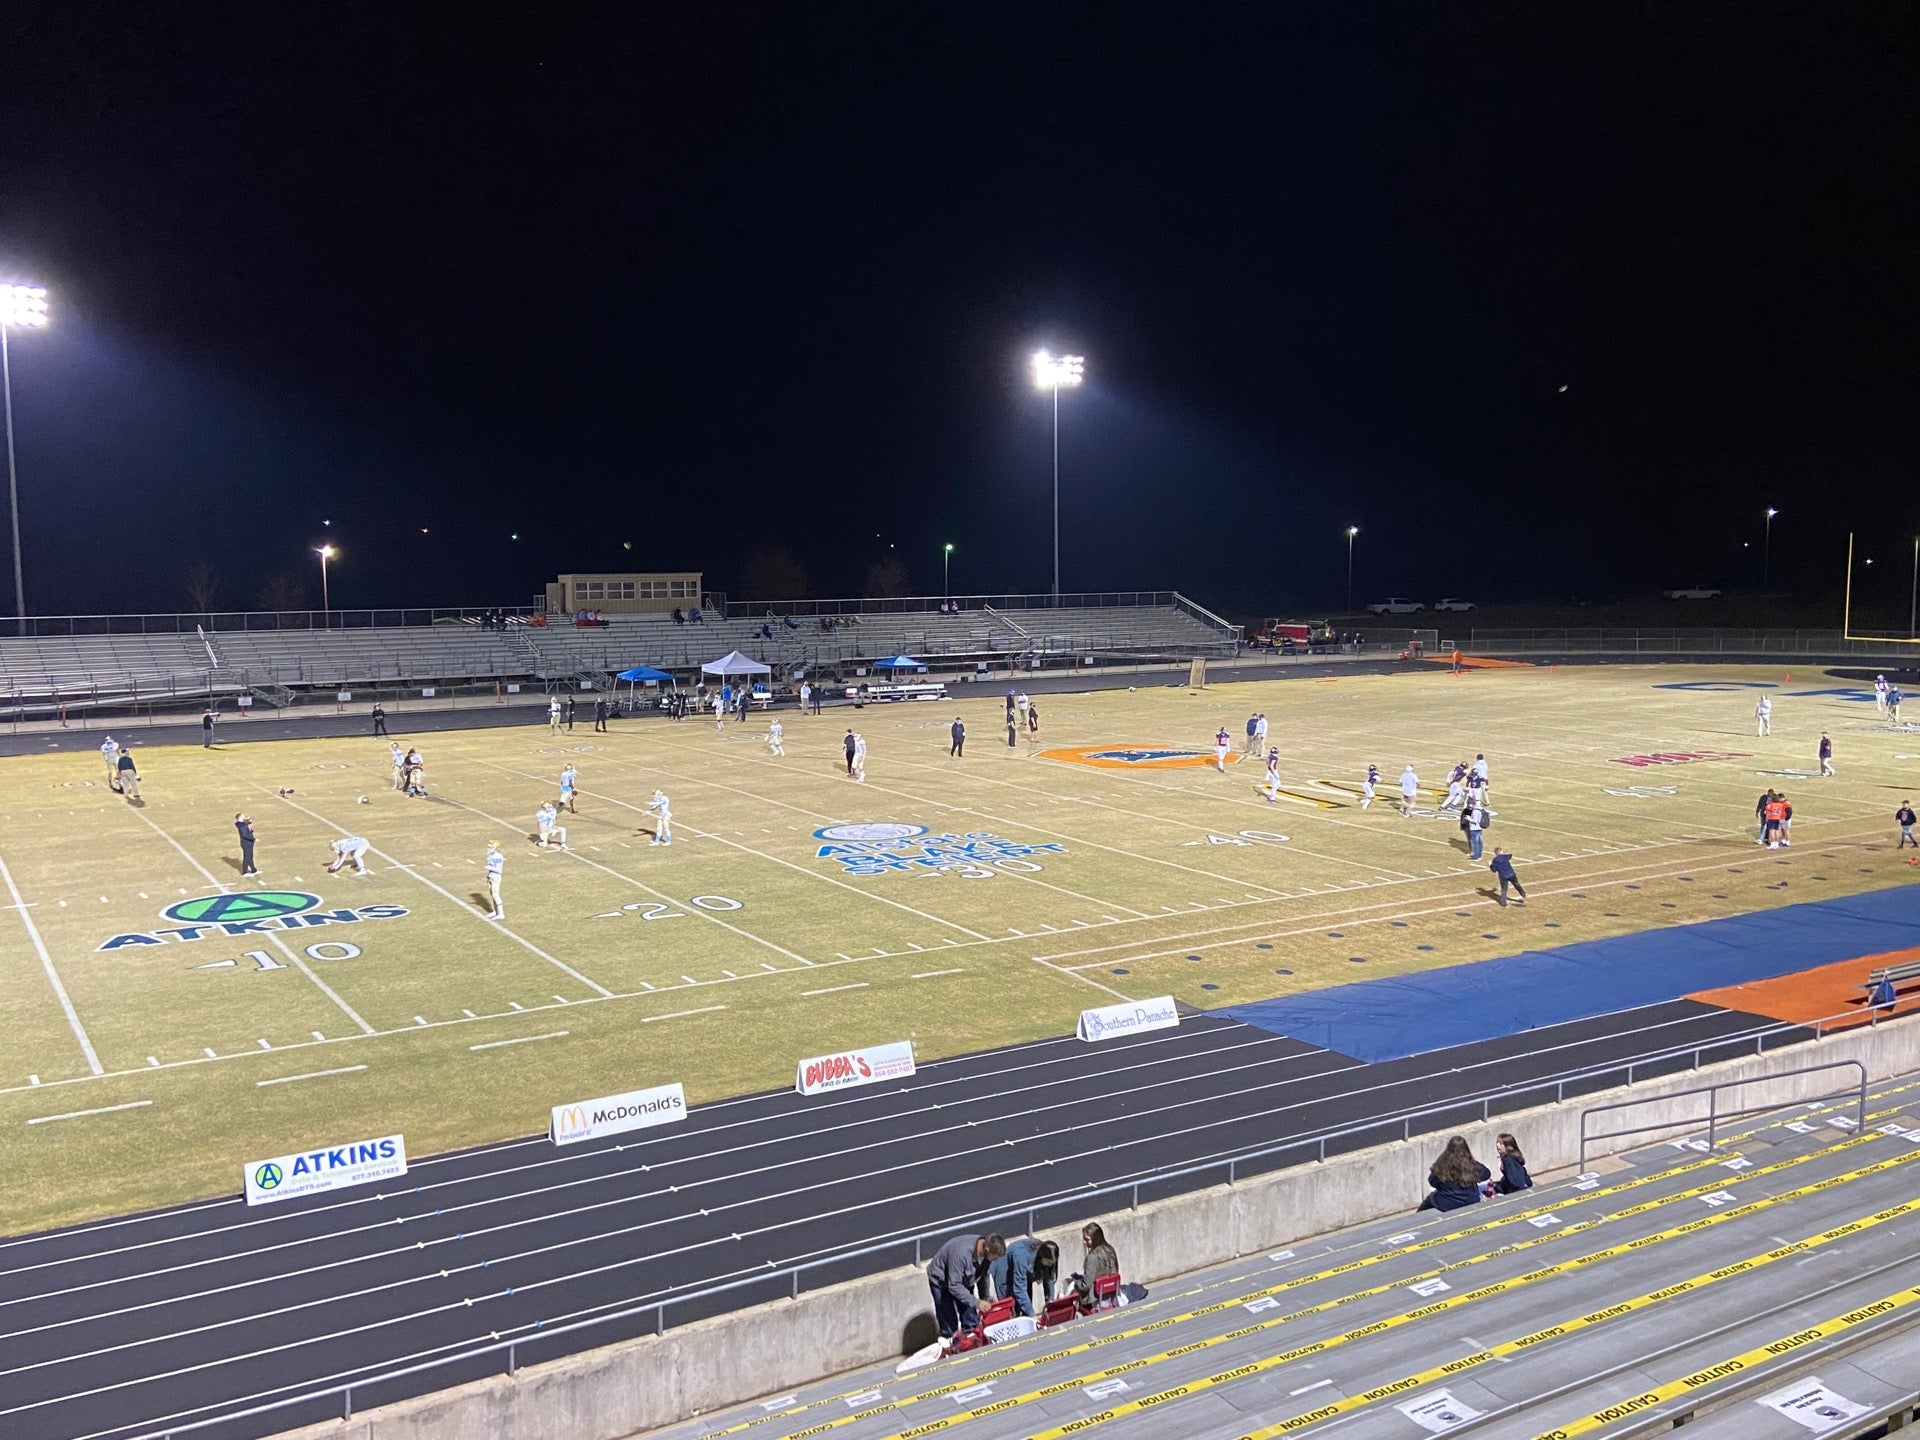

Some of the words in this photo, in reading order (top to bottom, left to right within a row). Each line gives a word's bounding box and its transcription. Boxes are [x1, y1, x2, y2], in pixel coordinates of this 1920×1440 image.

[815, 832, 1000, 858] Allstate
[834, 838, 1030, 868] BLAKE
[1207, 829, 1292, 846] 40
[937, 858, 1045, 879] 30
[620, 894, 745, 921] 20
[95, 904, 411, 951] ATKINS
[240, 941, 363, 972] 10
[1093, 1014, 1136, 1033] Southern
[1135, 1008, 1175, 1025] Panache
[805, 1055, 872, 1087] BUBBA'S
[592, 1096, 682, 1125] McDonald's
[292, 1139, 396, 1177] ATKINS
[1062, 1411, 1114, 1433] CAUTION
[1138, 1388, 1188, 1407] CAUTION
[1211, 1365, 1258, 1383] CAUTION
[1406, 1303, 1448, 1320] CAUTION
[1466, 1284, 1506, 1300] CAUTION
[1523, 1267, 1561, 1282] CAUTION
[1576, 1250, 1614, 1265] CAUTION
[1281, 1407, 1338, 1430] CAUTION
[1364, 1378, 1419, 1401] CAUTION
[1442, 1352, 1494, 1374] CAUTION
[1515, 1328, 1566, 1347] CAUTION
[1584, 1304, 1632, 1323] CAUTION
[1648, 1283, 1695, 1302] CAUTION
[1711, 1262, 1754, 1280] CAUTION
[1768, 1242, 1809, 1259] CAUTION
[1823, 1223, 1862, 1240] CAUTION
[789, 1423, 833, 1440] CAUTION
[854, 1404, 896, 1420] CAUTION
[917, 1386, 957, 1401] CAUTION
[976, 1367, 1015, 1383] CAUTION
[1033, 1350, 1071, 1365] CAUTION
[1142, 1319, 1176, 1332] CAUTION
[1191, 1304, 1225, 1317] CAUTION
[1286, 1275, 1319, 1288] CAUTION
[1594, 1395, 1660, 1424] CAUTION
[1682, 1361, 1744, 1387] CAUTION
[1765, 1330, 1822, 1355] CAUTION
[1841, 1301, 1895, 1325] CAUTION
[901, 1420, 949, 1439] CAUTION
[971, 1399, 1018, 1417] CAUTION
[1039, 1379, 1084, 1396] CAUTION
[1104, 1360, 1147, 1376] CAUTION
[1167, 1342, 1208, 1358] CAUTION
[1226, 1325, 1265, 1340] CAUTION
